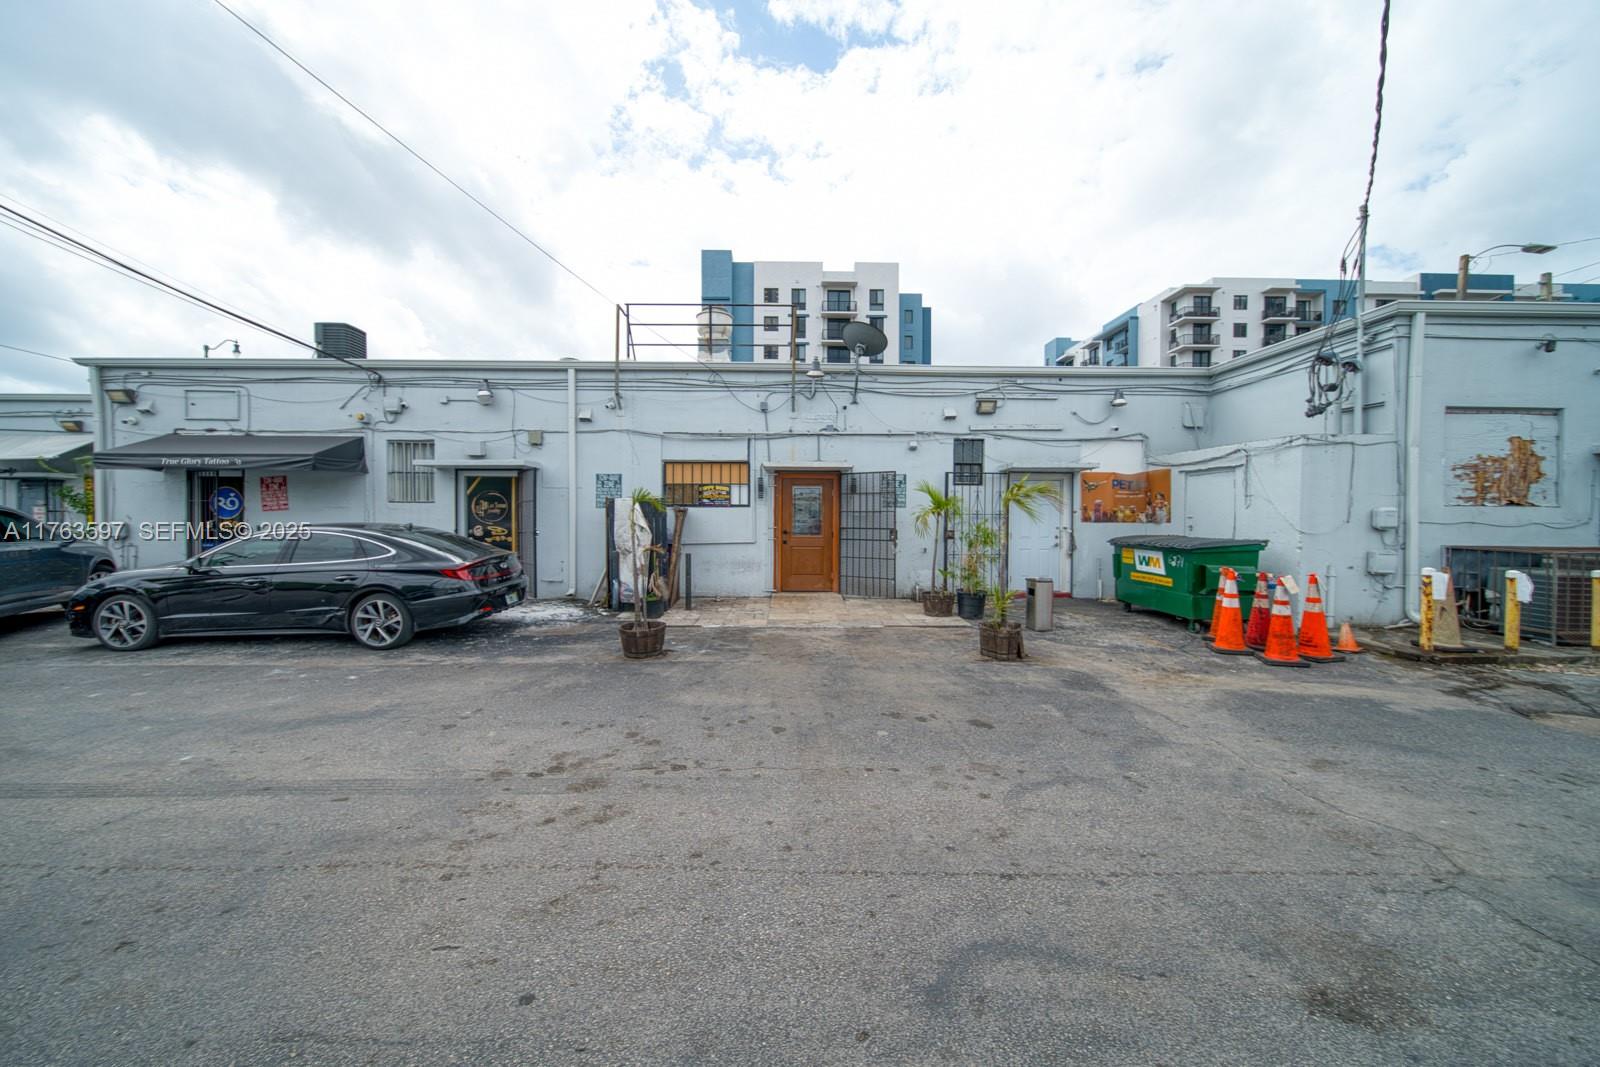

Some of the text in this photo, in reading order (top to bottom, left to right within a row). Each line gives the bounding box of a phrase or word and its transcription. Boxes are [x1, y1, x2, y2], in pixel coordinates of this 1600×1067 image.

[161, 456, 230, 467] True Glory Tattoo
[1137, 554, 1162, 569] WM
